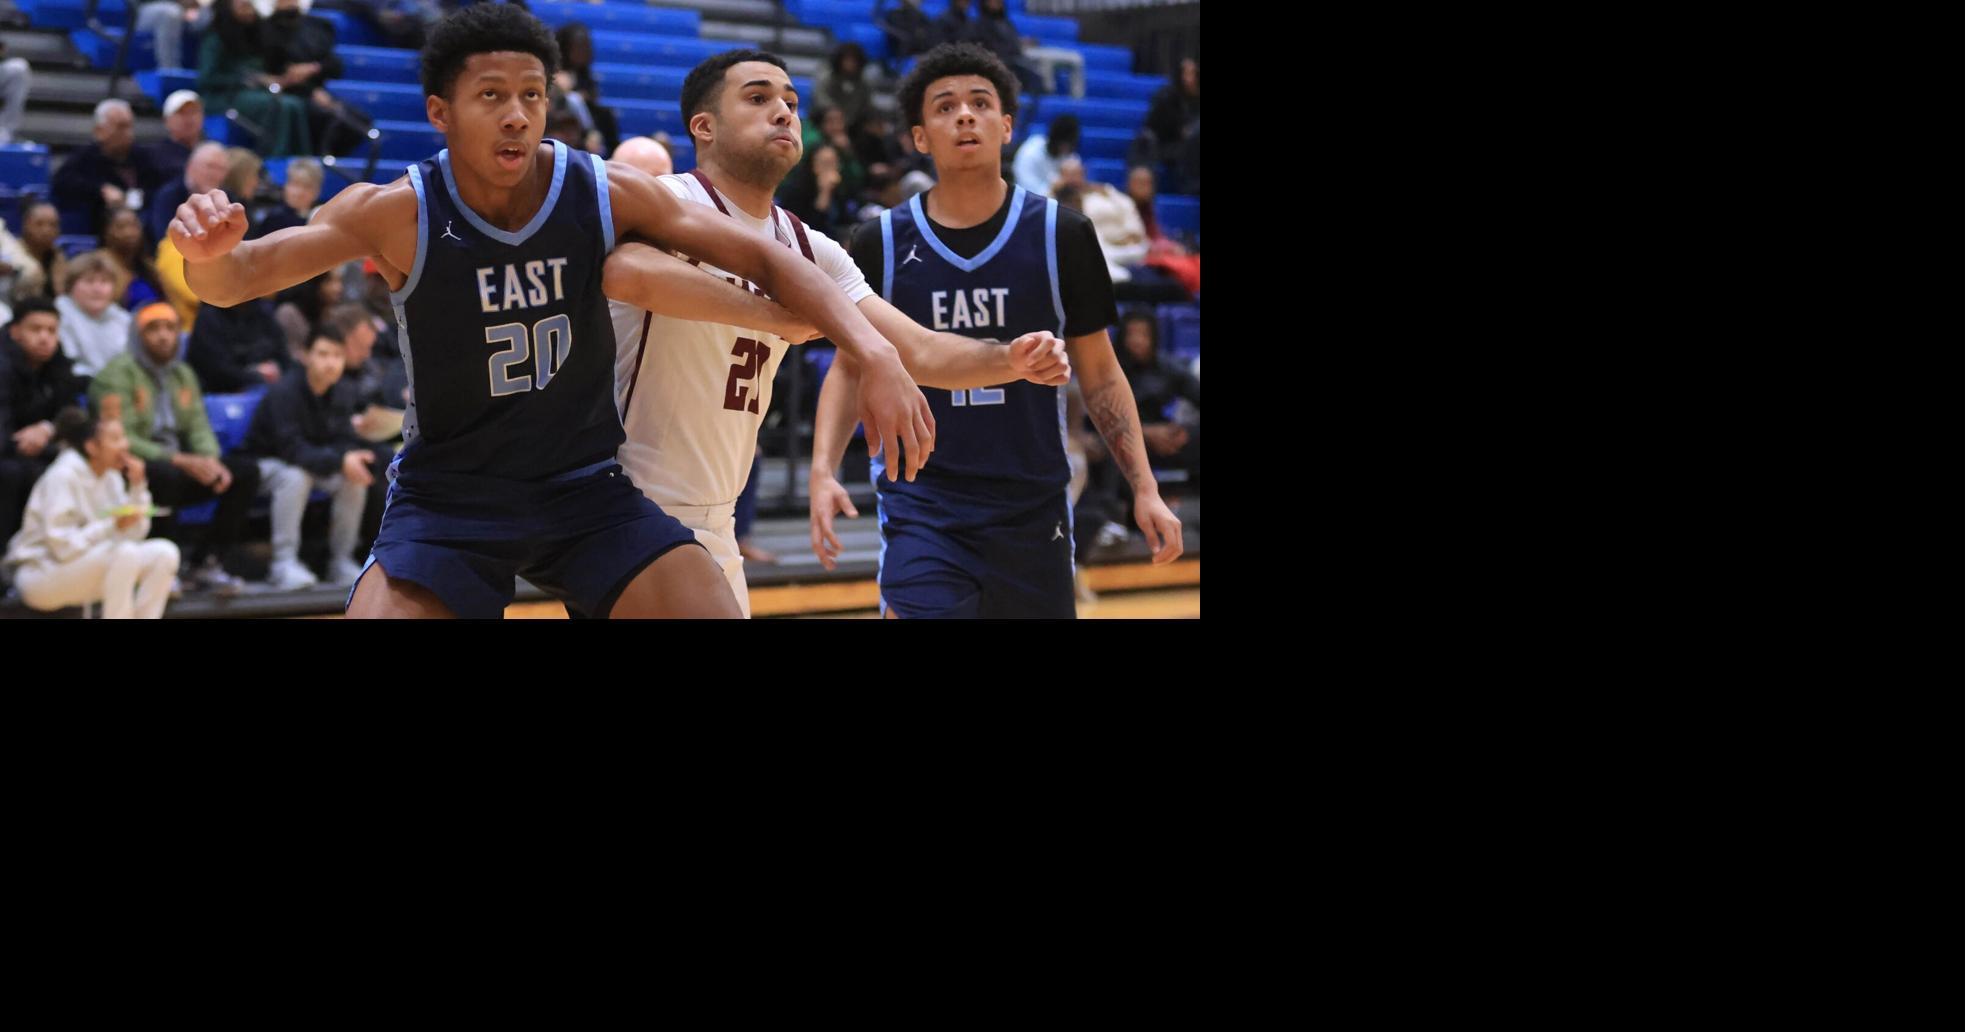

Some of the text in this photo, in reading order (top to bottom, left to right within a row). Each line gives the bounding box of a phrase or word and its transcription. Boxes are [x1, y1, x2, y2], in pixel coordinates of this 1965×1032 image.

[476, 257, 568, 313] EAST
[931, 287, 1009, 330] EAST
[484, 313, 572, 397] 20
